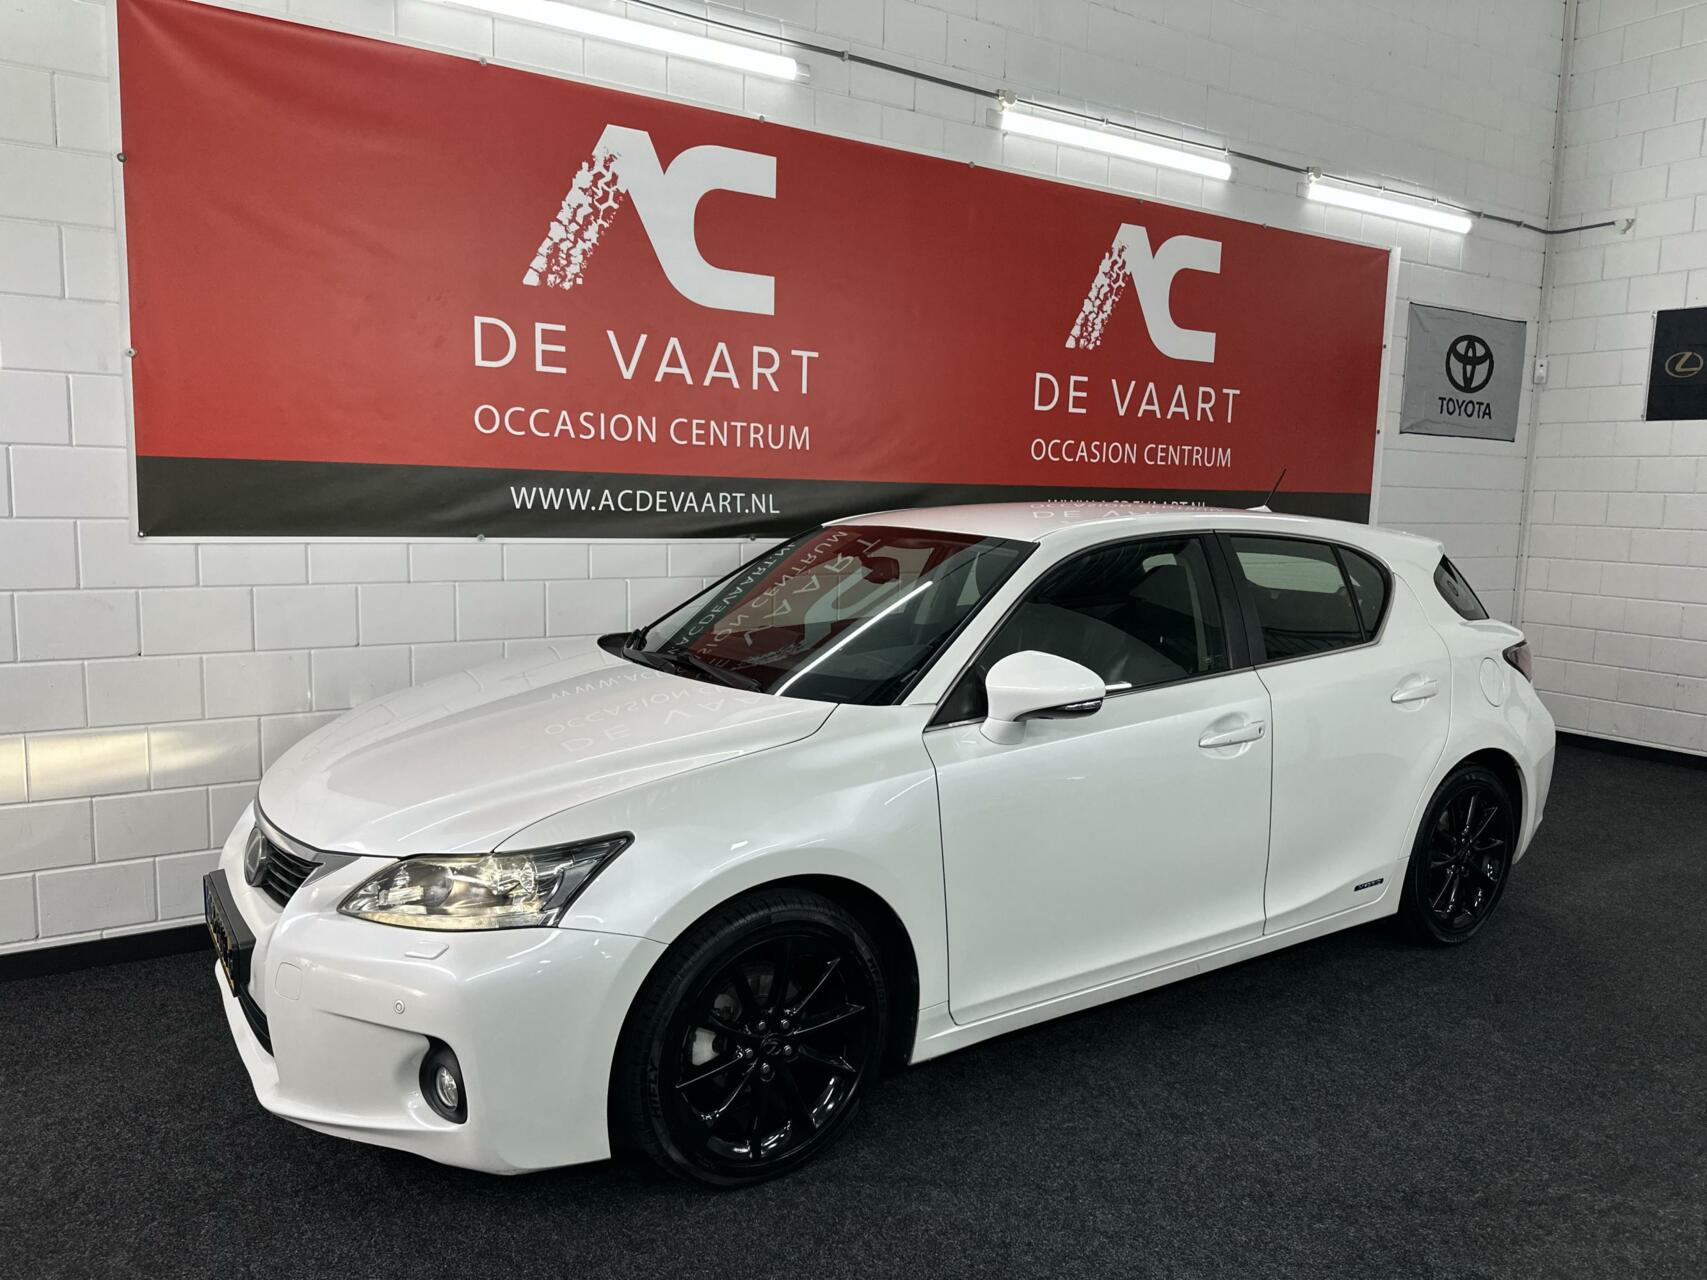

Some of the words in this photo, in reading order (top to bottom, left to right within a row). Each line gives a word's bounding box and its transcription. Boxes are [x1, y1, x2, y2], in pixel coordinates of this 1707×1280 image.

[474, 315, 567, 374] DE
[606, 330, 819, 394] VAART
[1034, 372, 1089, 414] DE
[1111, 378, 1241, 423] VAART
[1438, 396, 1492, 420] TOYOTA
[474, 404, 656, 443] OCCASION
[669, 417, 811, 451] CENTRUM
[1030, 438, 1137, 464] OCCASION
[1144, 443, 1231, 468] CENTRUM
[510, 486, 781, 514] WWW.ACDEVAART.NL
